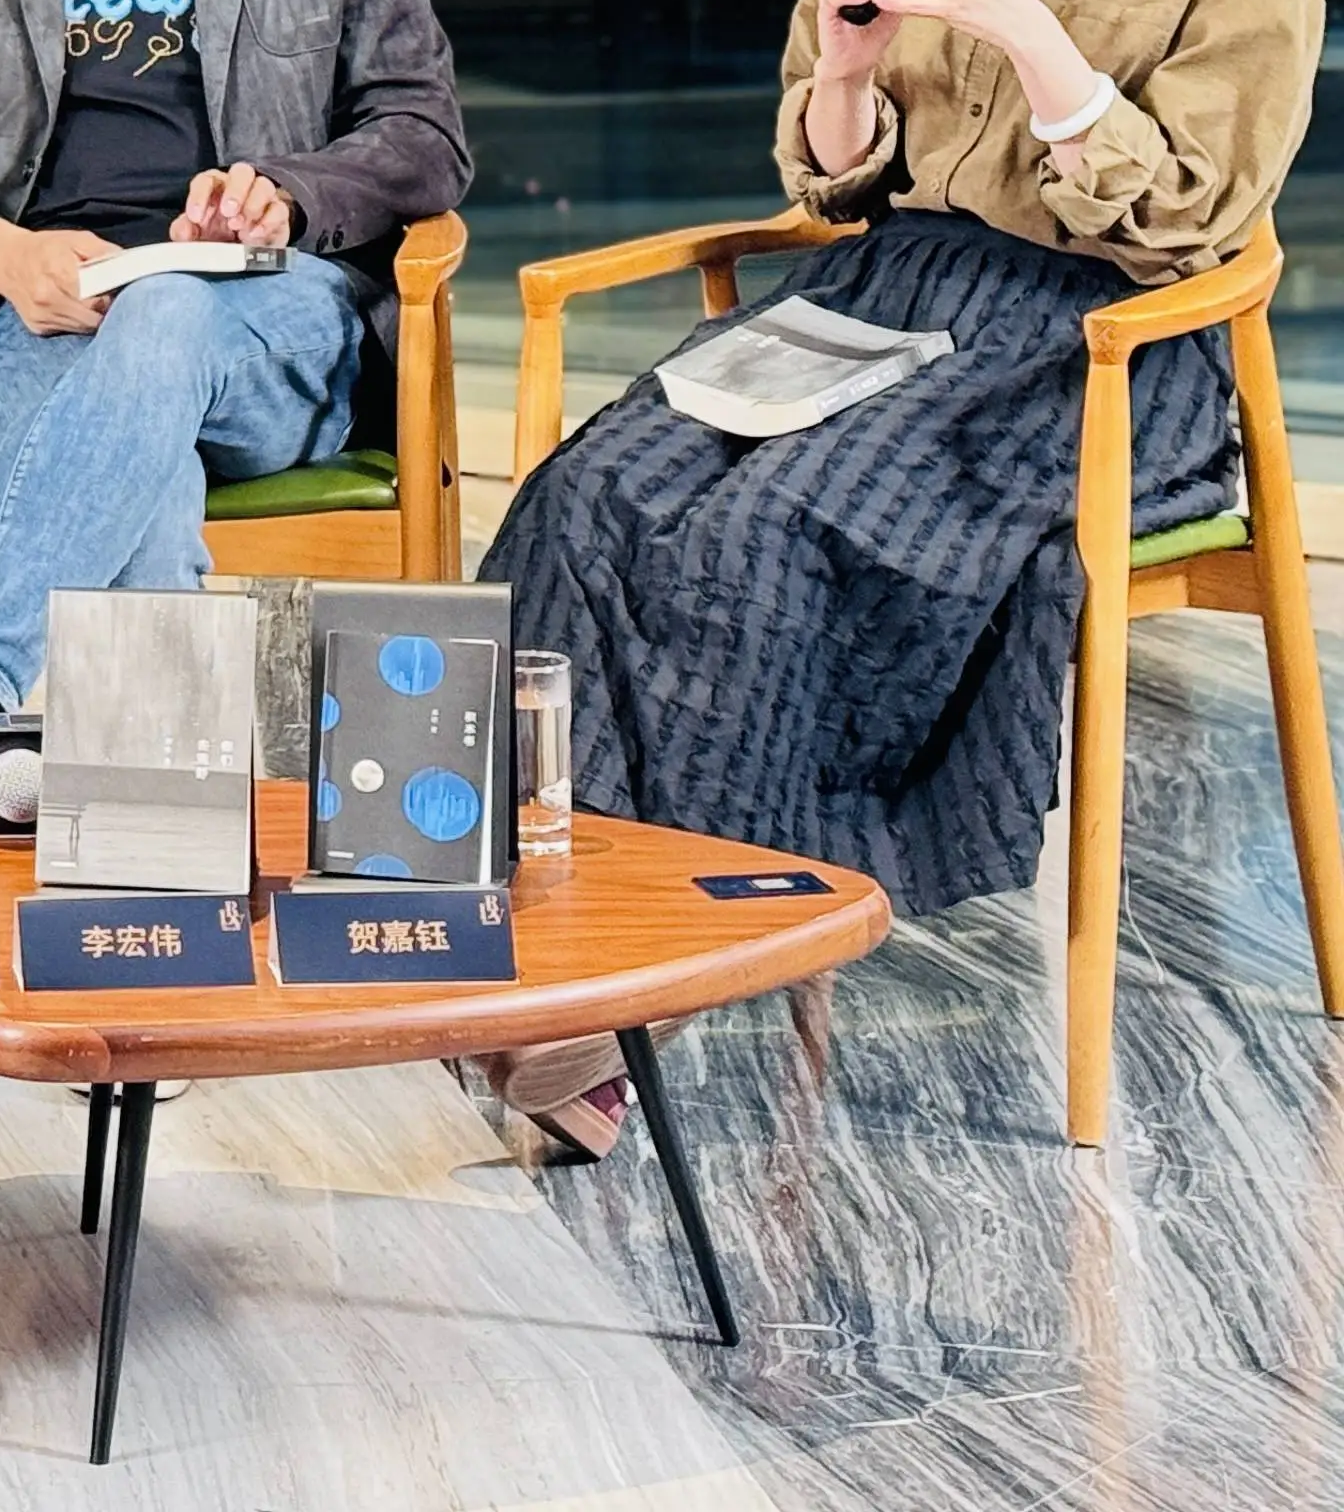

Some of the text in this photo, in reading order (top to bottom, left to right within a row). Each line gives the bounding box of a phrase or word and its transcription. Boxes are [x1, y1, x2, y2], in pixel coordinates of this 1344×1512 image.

[80, 924, 182, 959] 李宏伟
[346, 919, 451, 954] 贺嘉钰
